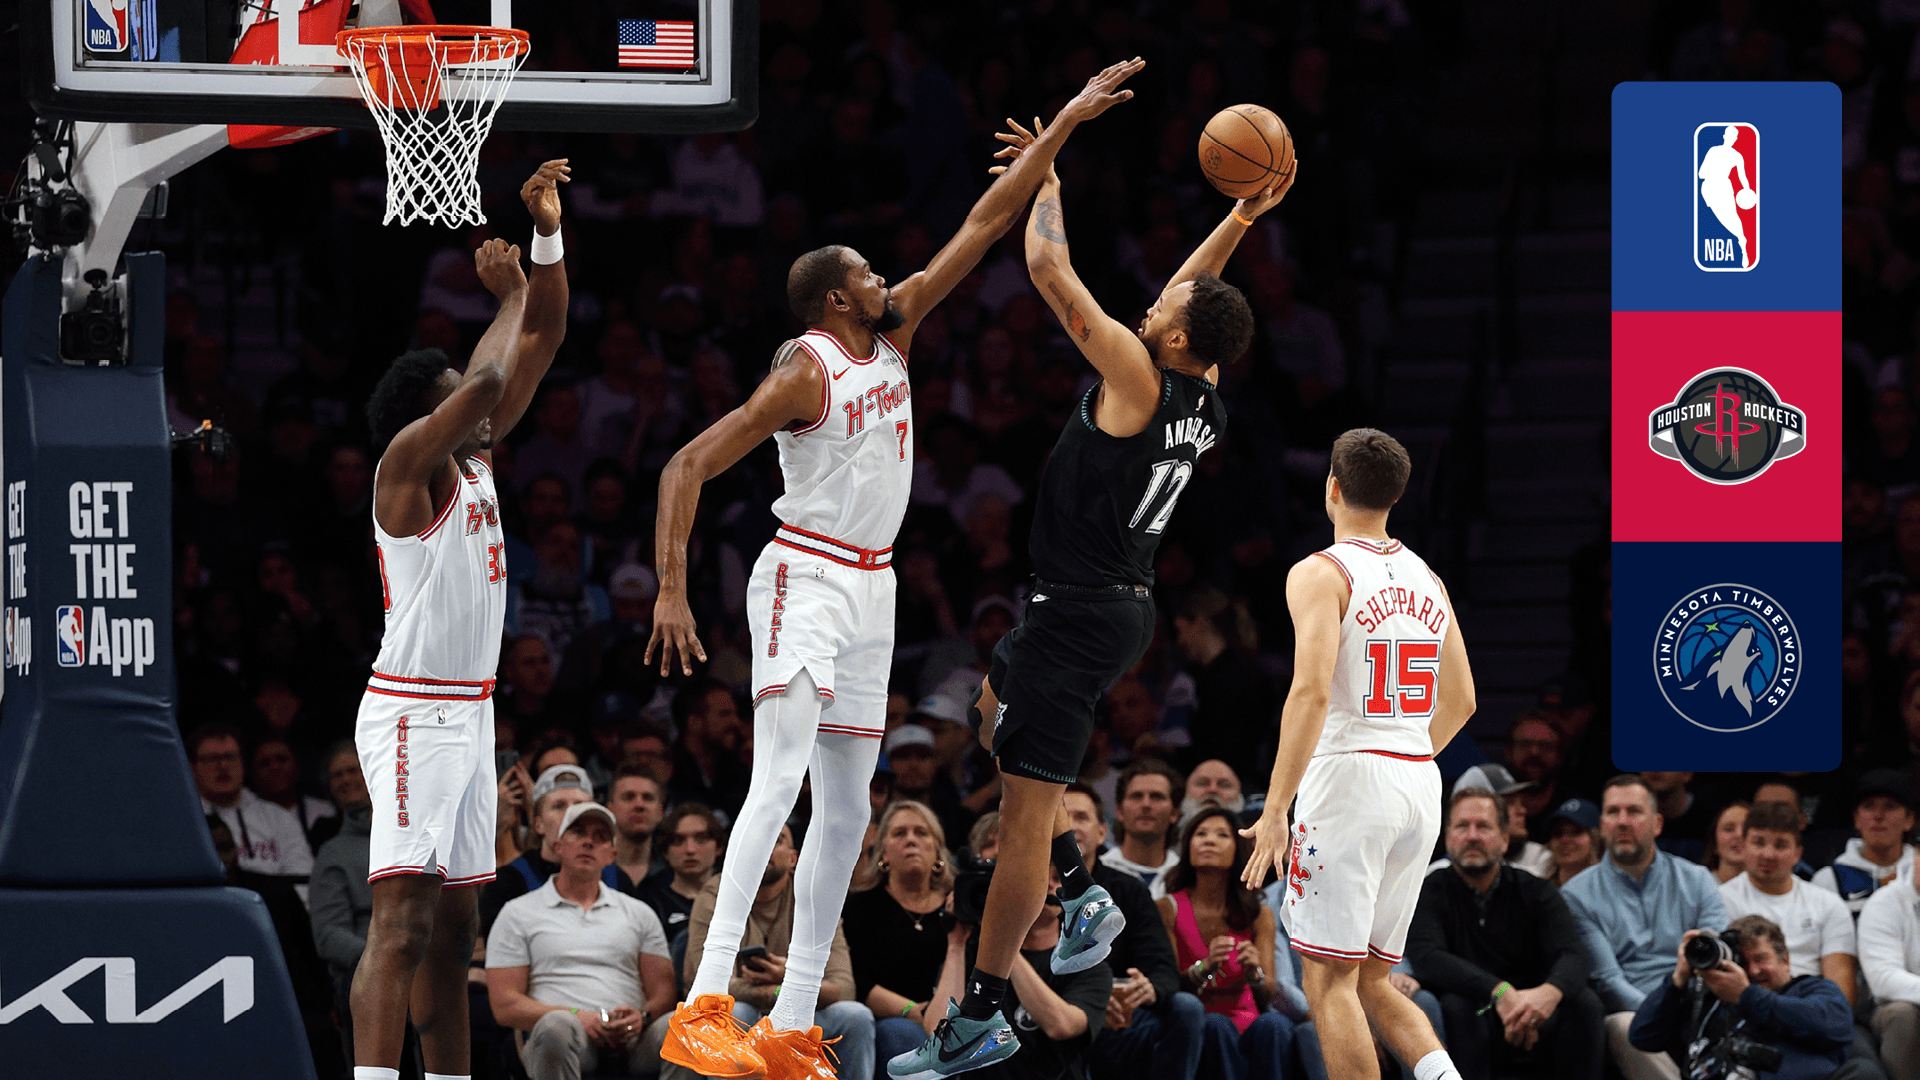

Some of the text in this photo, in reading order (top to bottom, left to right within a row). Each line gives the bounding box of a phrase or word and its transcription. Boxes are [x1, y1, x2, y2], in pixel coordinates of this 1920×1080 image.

[92, 29, 115, 46] NBA
[895, 419, 909, 462] 7
[8, 480, 26, 539] GET
[69, 481, 133, 538] GET
[1128, 458, 1193, 534] 12
[8, 542, 27, 599] THE
[69, 544, 137, 599] THE
[767, 562, 788, 658] ROCKETS
[1355, 586, 1446, 634] SHEPPARD
[13, 607, 32, 676] App
[88, 606, 155, 677] App
[1363, 638, 1441, 717] 15
[396, 716, 409, 827] ROCKETS
